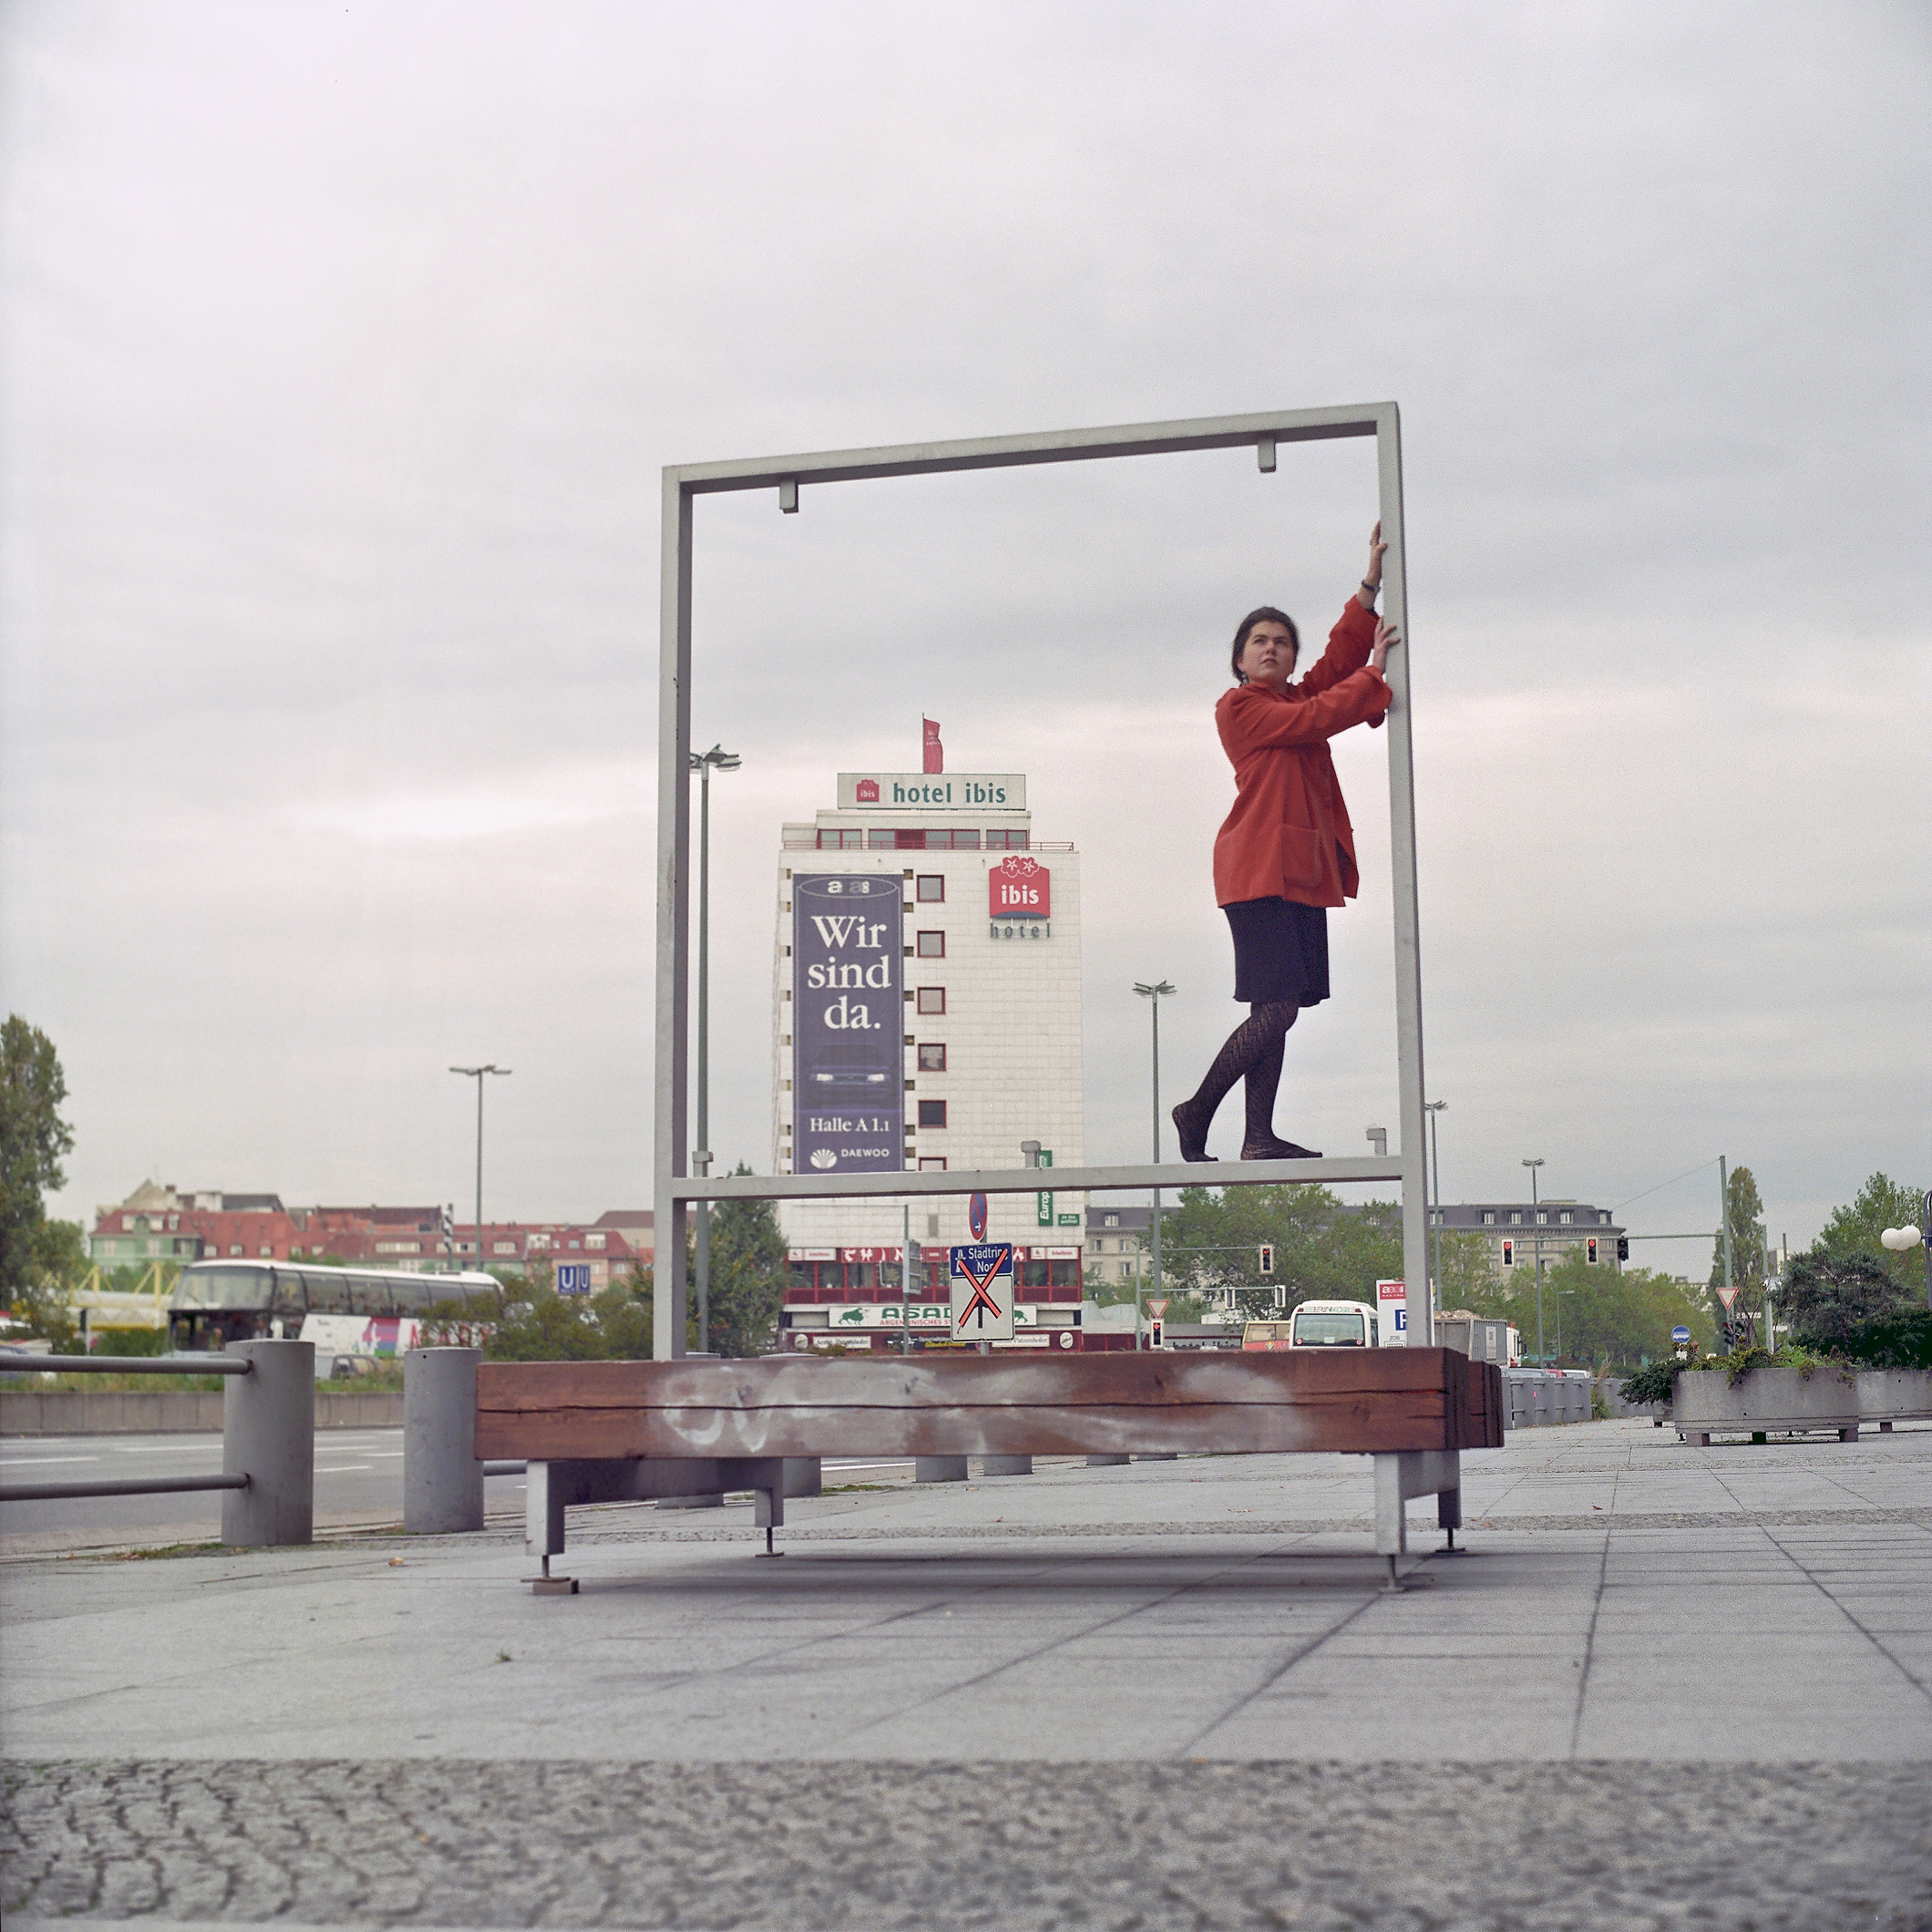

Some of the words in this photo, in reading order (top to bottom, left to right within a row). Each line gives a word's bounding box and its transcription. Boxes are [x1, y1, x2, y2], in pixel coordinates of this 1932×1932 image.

[893, 782, 951, 803] hotel
[965, 782, 1006, 804] ibis
[1001, 884, 1039, 905] ibis
[810, 915, 888, 949] Wir
[990, 922, 1051, 940] hotel
[807, 954, 891, 989] sind
[824, 996, 881, 1030] da.
[810, 1117, 853, 1132] Halle
[855, 1117, 868, 1132] A
[841, 1148, 890, 1157] DAEWOO
[977, 1260, 995, 1273] Nor
[561, 1268, 574, 1289] U
[581, 1269, 589, 1288] U
